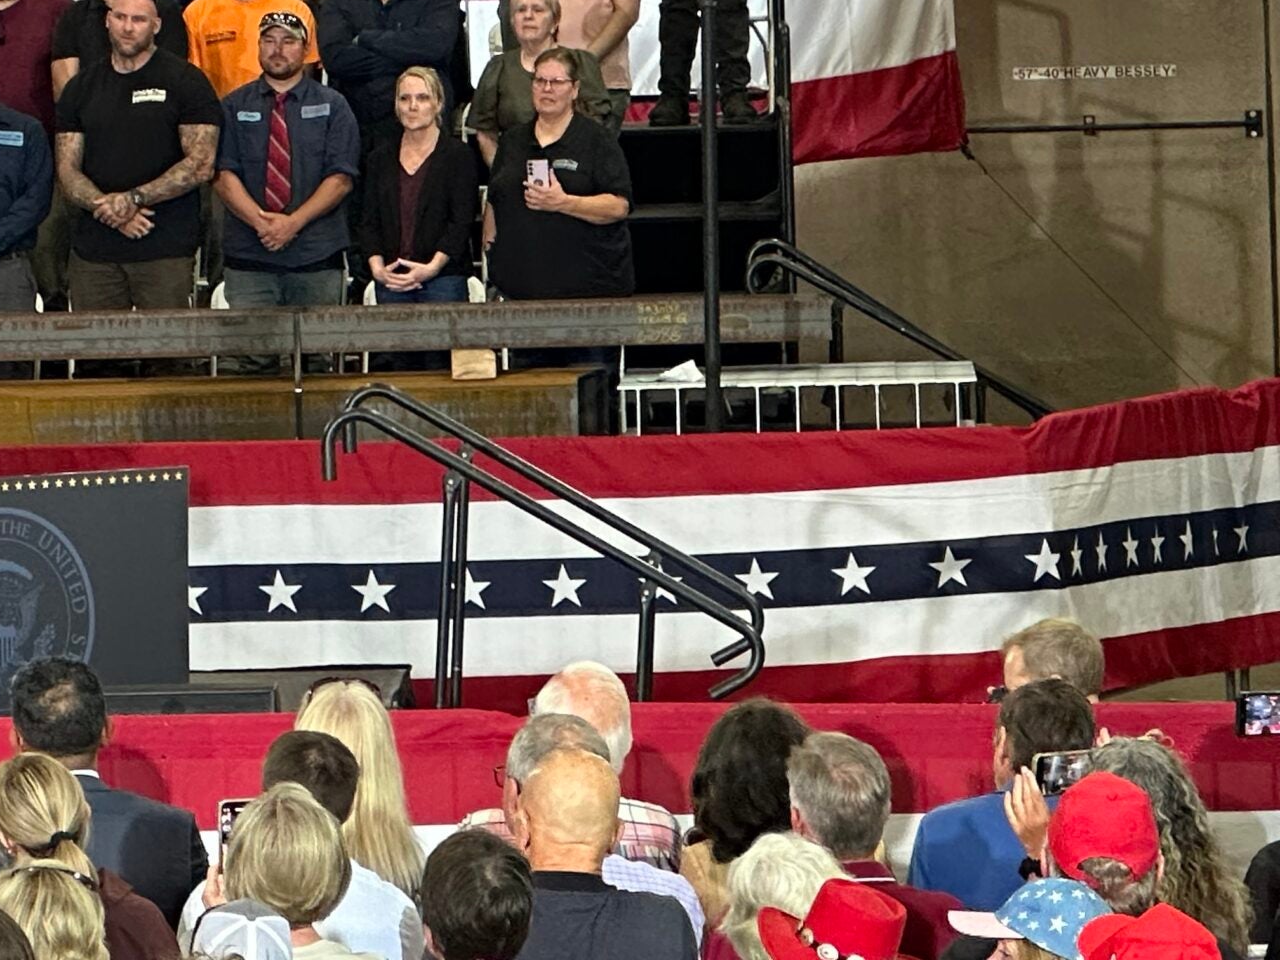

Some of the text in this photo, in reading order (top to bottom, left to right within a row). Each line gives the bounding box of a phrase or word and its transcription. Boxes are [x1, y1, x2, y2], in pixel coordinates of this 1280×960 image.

[1115, 65, 1171, 78] BESSEY
[0, 519, 33, 539] THE
[38, 530, 87, 614] UNITED
